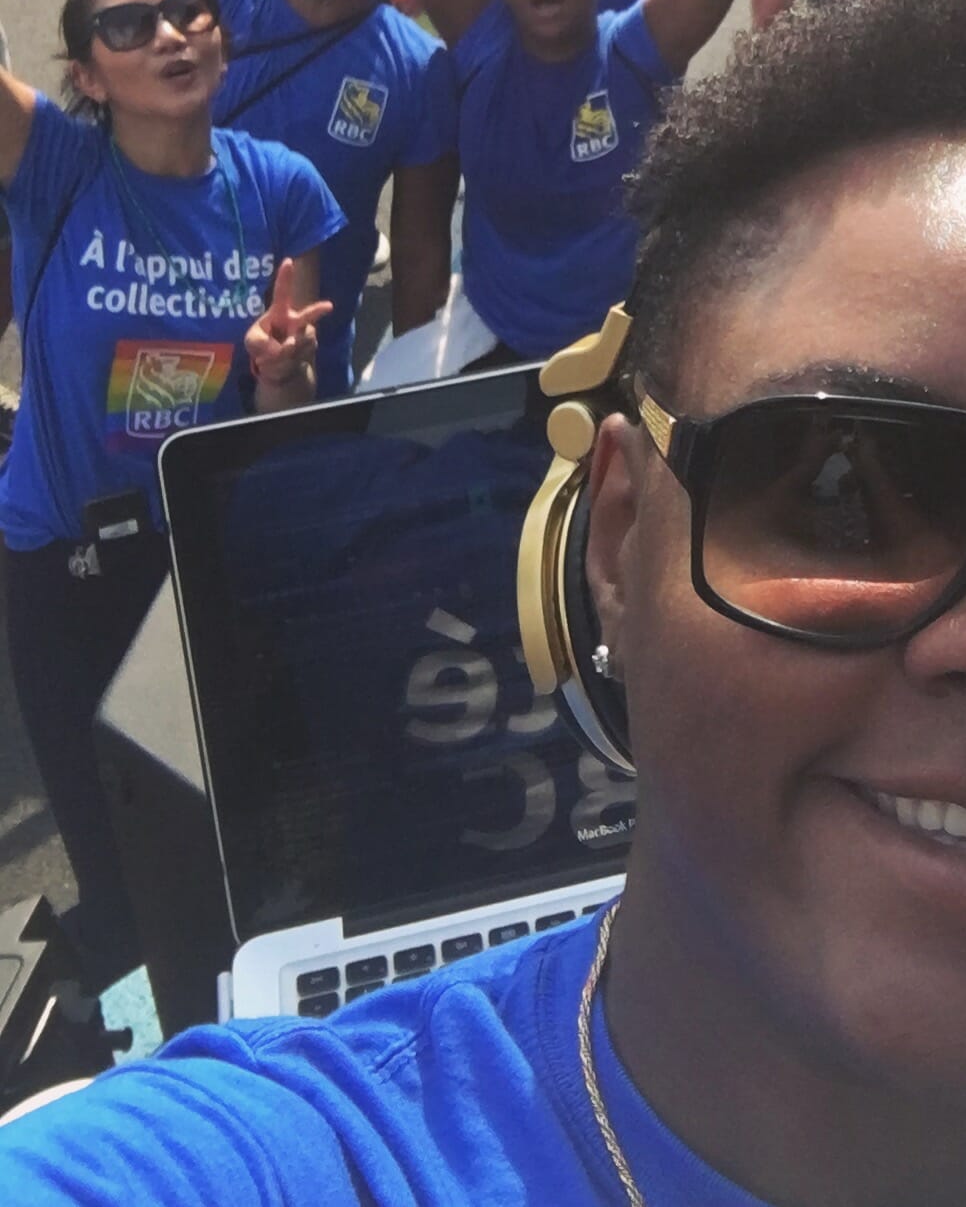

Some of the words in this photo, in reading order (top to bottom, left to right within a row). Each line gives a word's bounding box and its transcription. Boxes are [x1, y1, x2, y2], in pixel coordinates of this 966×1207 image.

[334, 119, 372, 143] RBC
[576, 135, 614, 158] RBC
[80, 229, 105, 269] À
[117, 239, 213, 285] l'appui
[223, 249, 275, 281] des
[86, 282, 266, 319] collectivité
[133, 407, 192, 431] RBC
[577, 820, 628, 843] MacBook
